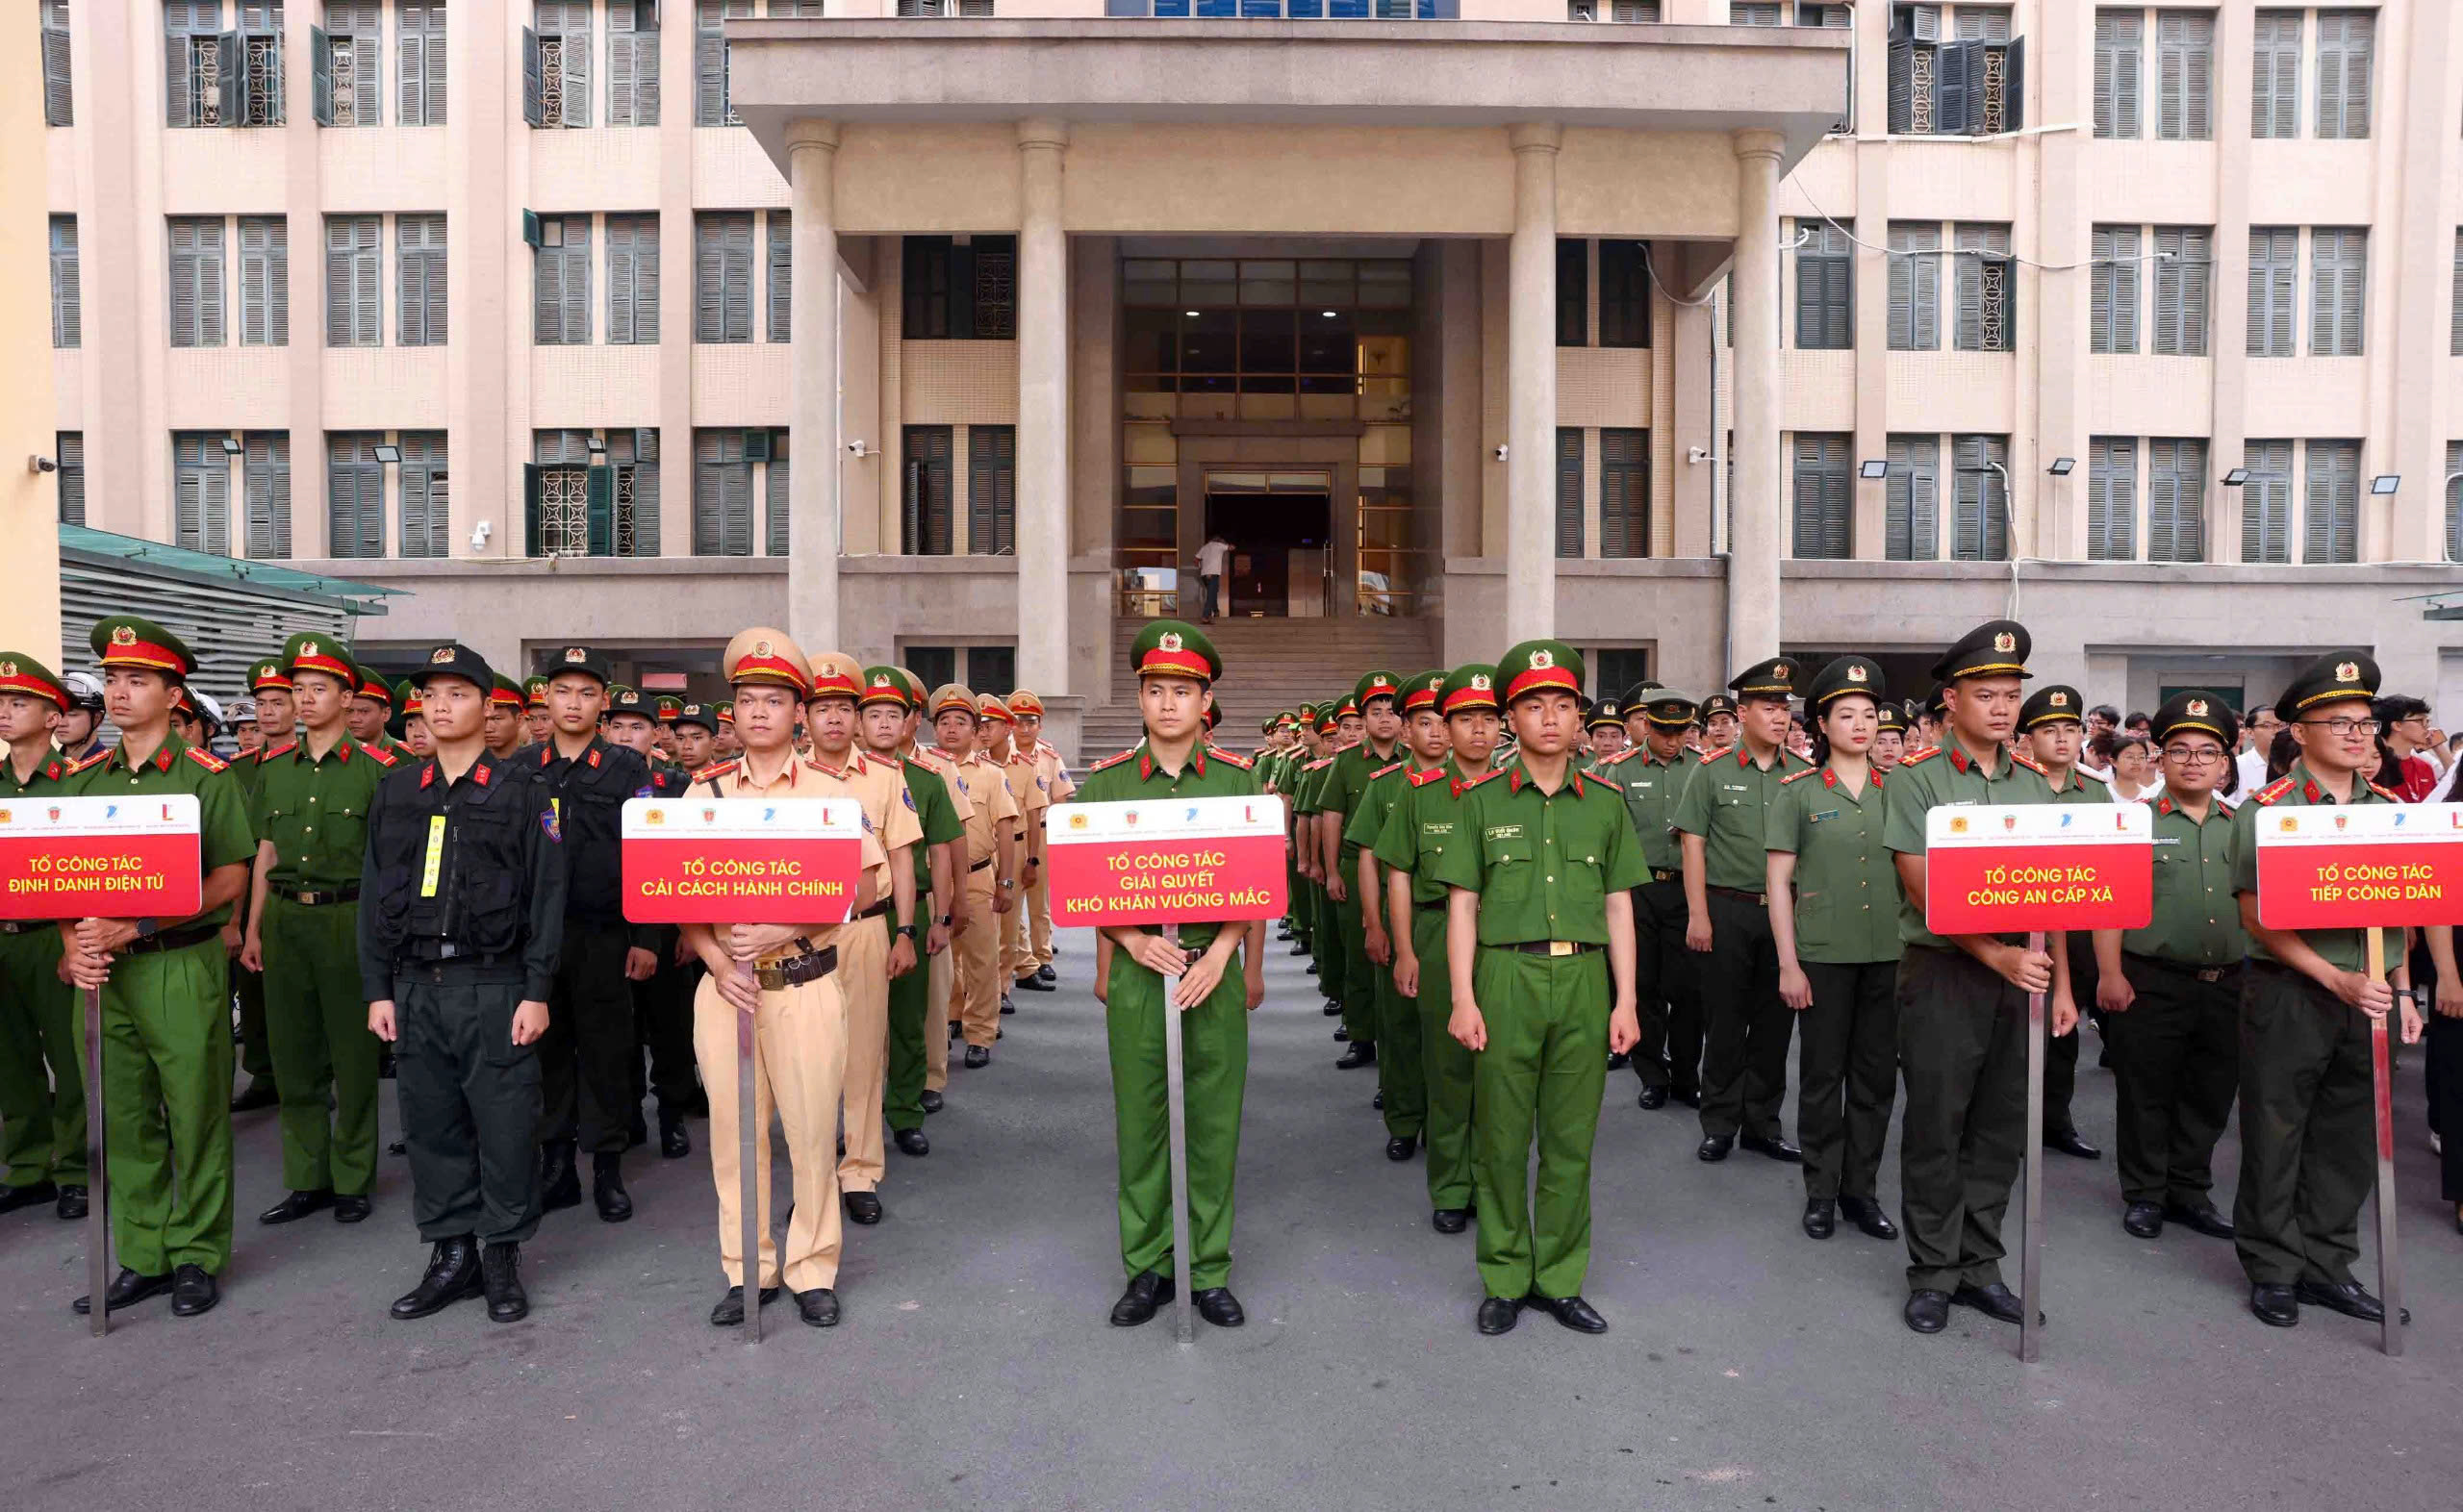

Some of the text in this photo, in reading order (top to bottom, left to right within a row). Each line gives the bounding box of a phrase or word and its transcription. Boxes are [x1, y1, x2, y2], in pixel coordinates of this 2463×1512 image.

[29, 853, 142, 872] TỔ CÔNG TÁC
[427, 824, 440, 888] POICE
[681, 856, 801, 876] TỔ CÔNG TÁC
[1106, 849, 1227, 871] TỔ CÔNG TÁC
[1119, 869, 1215, 891] GIẢI QUYẾT
[1985, 865, 2096, 885] TỔ CÔNG TÁC
[2316, 862, 2433, 882] TỔ CÔNG TÁC
[8, 871, 165, 895] ĐỊNH DANH ĐIỆN TỬ
[641, 877, 844, 896] CẢI CÁCH HÀNH CHÍNH
[2309, 882, 2442, 901] TIẾP CÔNG DÂN
[1066, 886, 1271, 913] KHÓ KHĂN VƯỚNG MẮC
[1967, 884, 2114, 906] CÔNG AN CẤP XÃ
